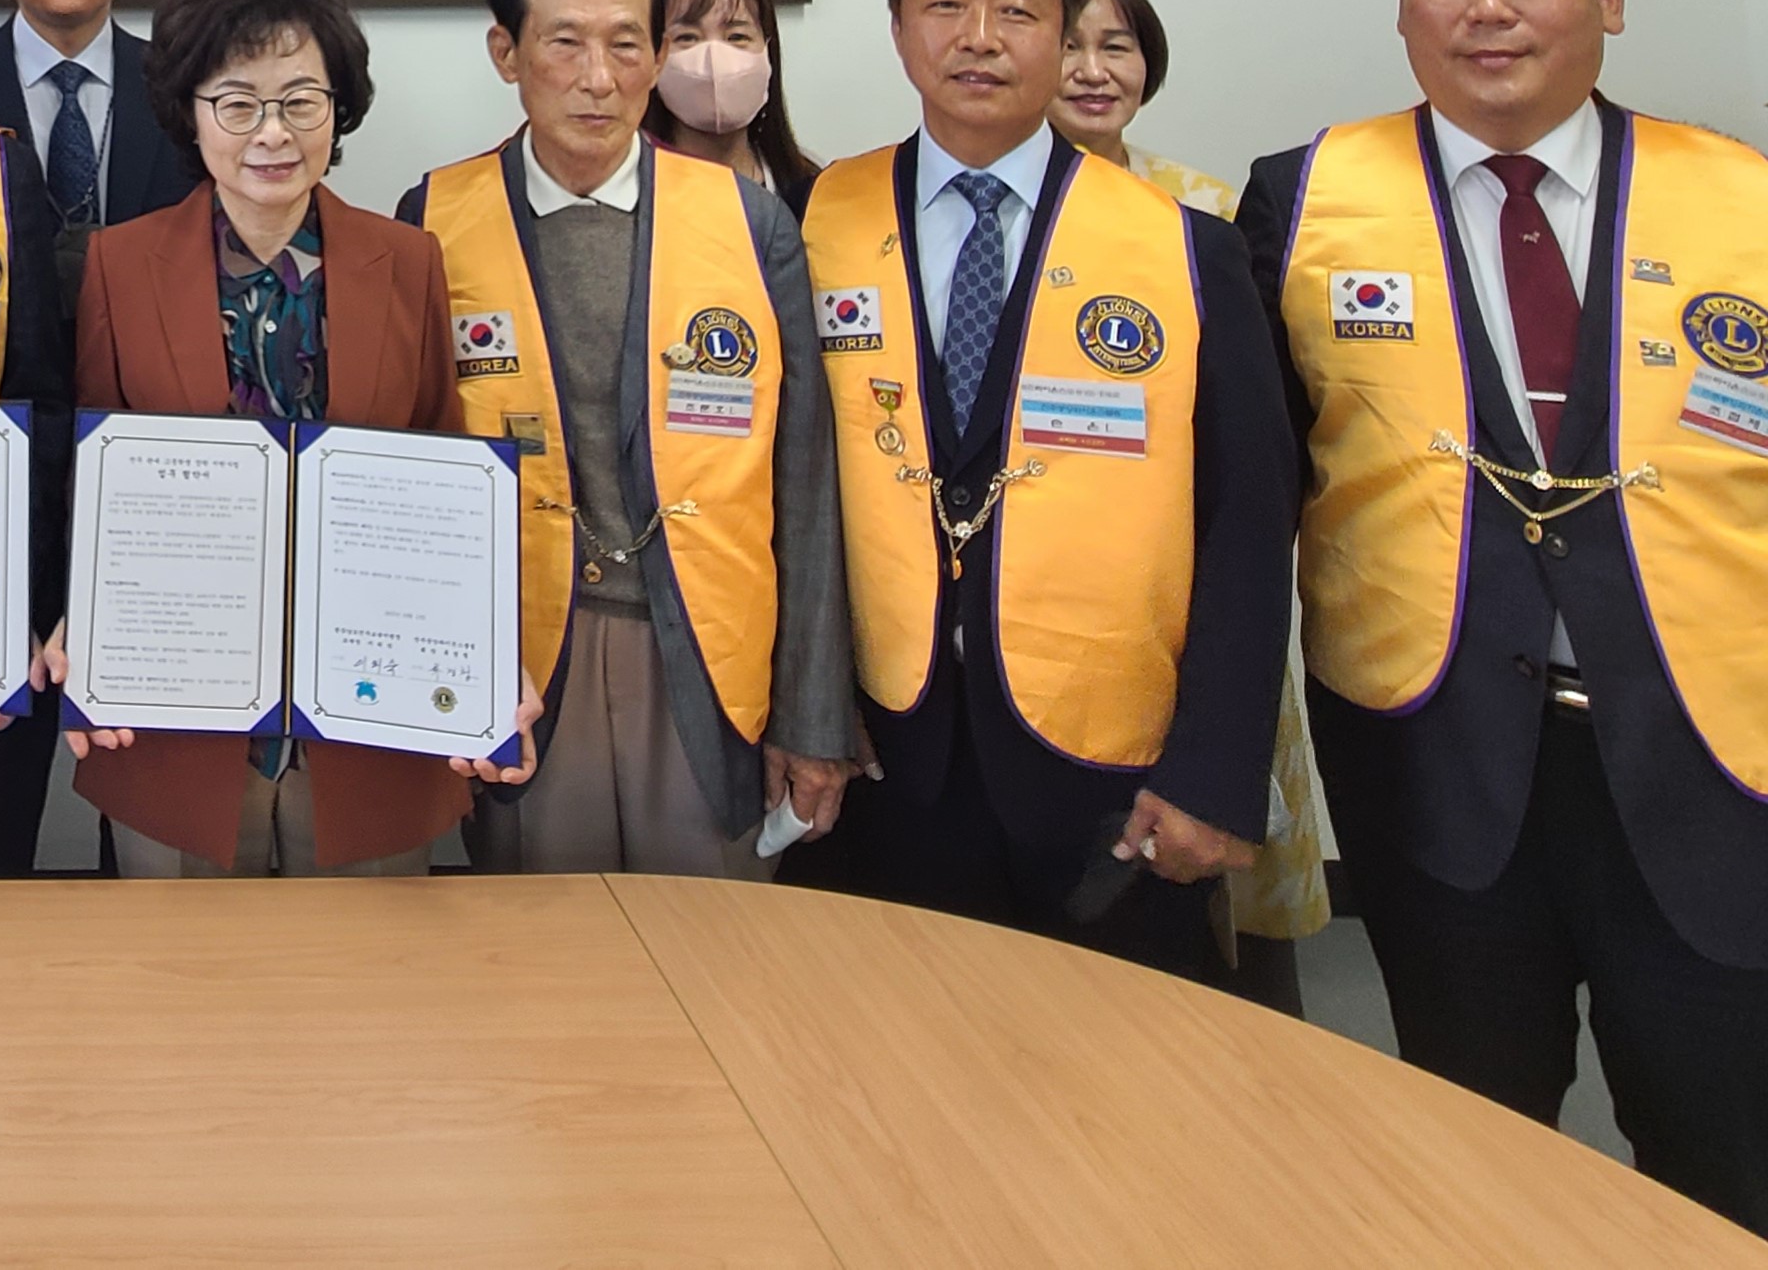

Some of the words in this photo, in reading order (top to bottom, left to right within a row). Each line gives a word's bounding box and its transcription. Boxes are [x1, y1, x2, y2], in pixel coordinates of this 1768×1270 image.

[1104, 301, 1146, 325] LIONS
[1709, 300, 1764, 322] LIONS
[1107, 318, 1129, 349] L
[1340, 322, 1411, 338] KOREA
[1724, 318, 1748, 350] L
[709, 331, 732, 358] L
[825, 335, 882, 351] KOREA
